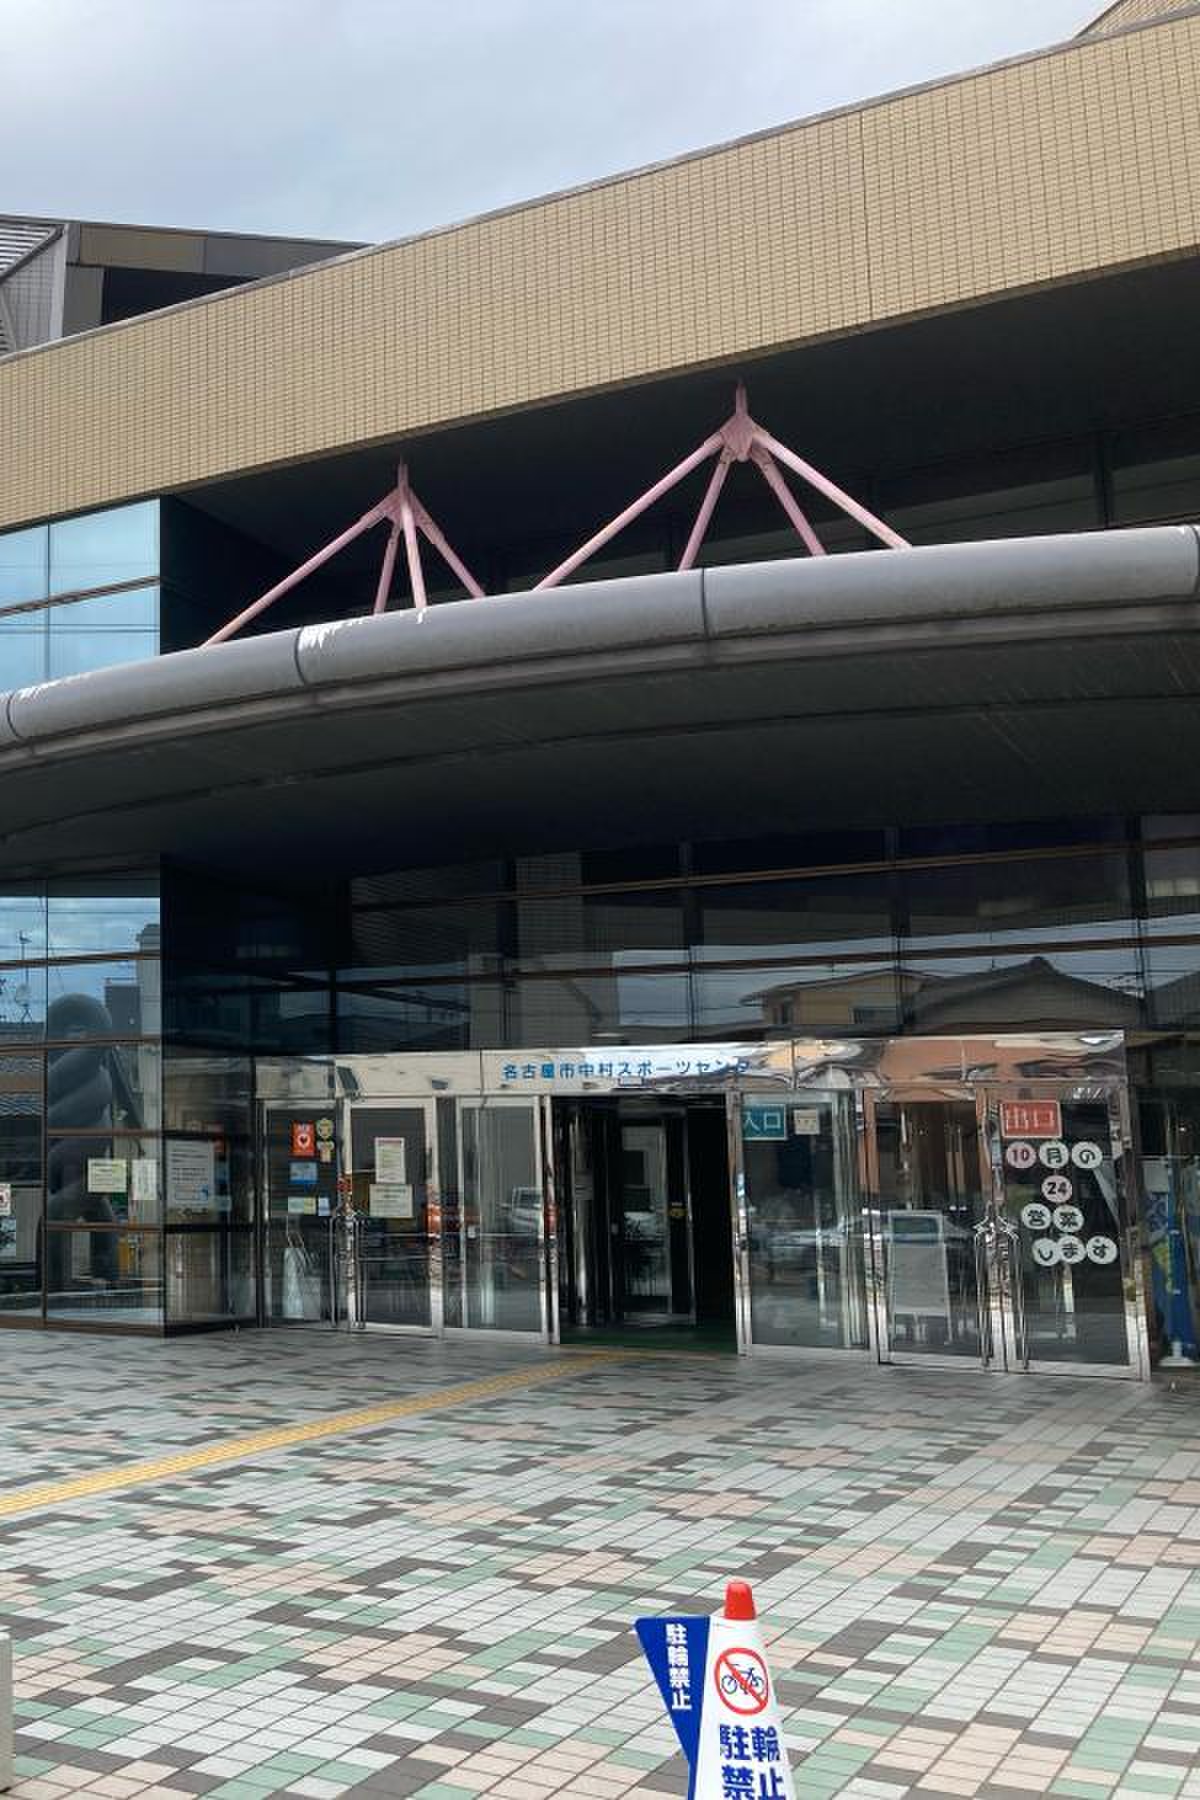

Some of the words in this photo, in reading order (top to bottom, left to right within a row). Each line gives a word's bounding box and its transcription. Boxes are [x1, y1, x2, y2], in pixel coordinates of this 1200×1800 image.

[503, 1060, 768, 1079] 名古屋市中村スポーツセンタ
[743, 1111, 780, 1132] 入口
[665, 1623, 692, 1710] 駐輪禁止
[720, 1724, 780, 1762] 駐輪
[721, 1765, 786, 1800] 禁止
